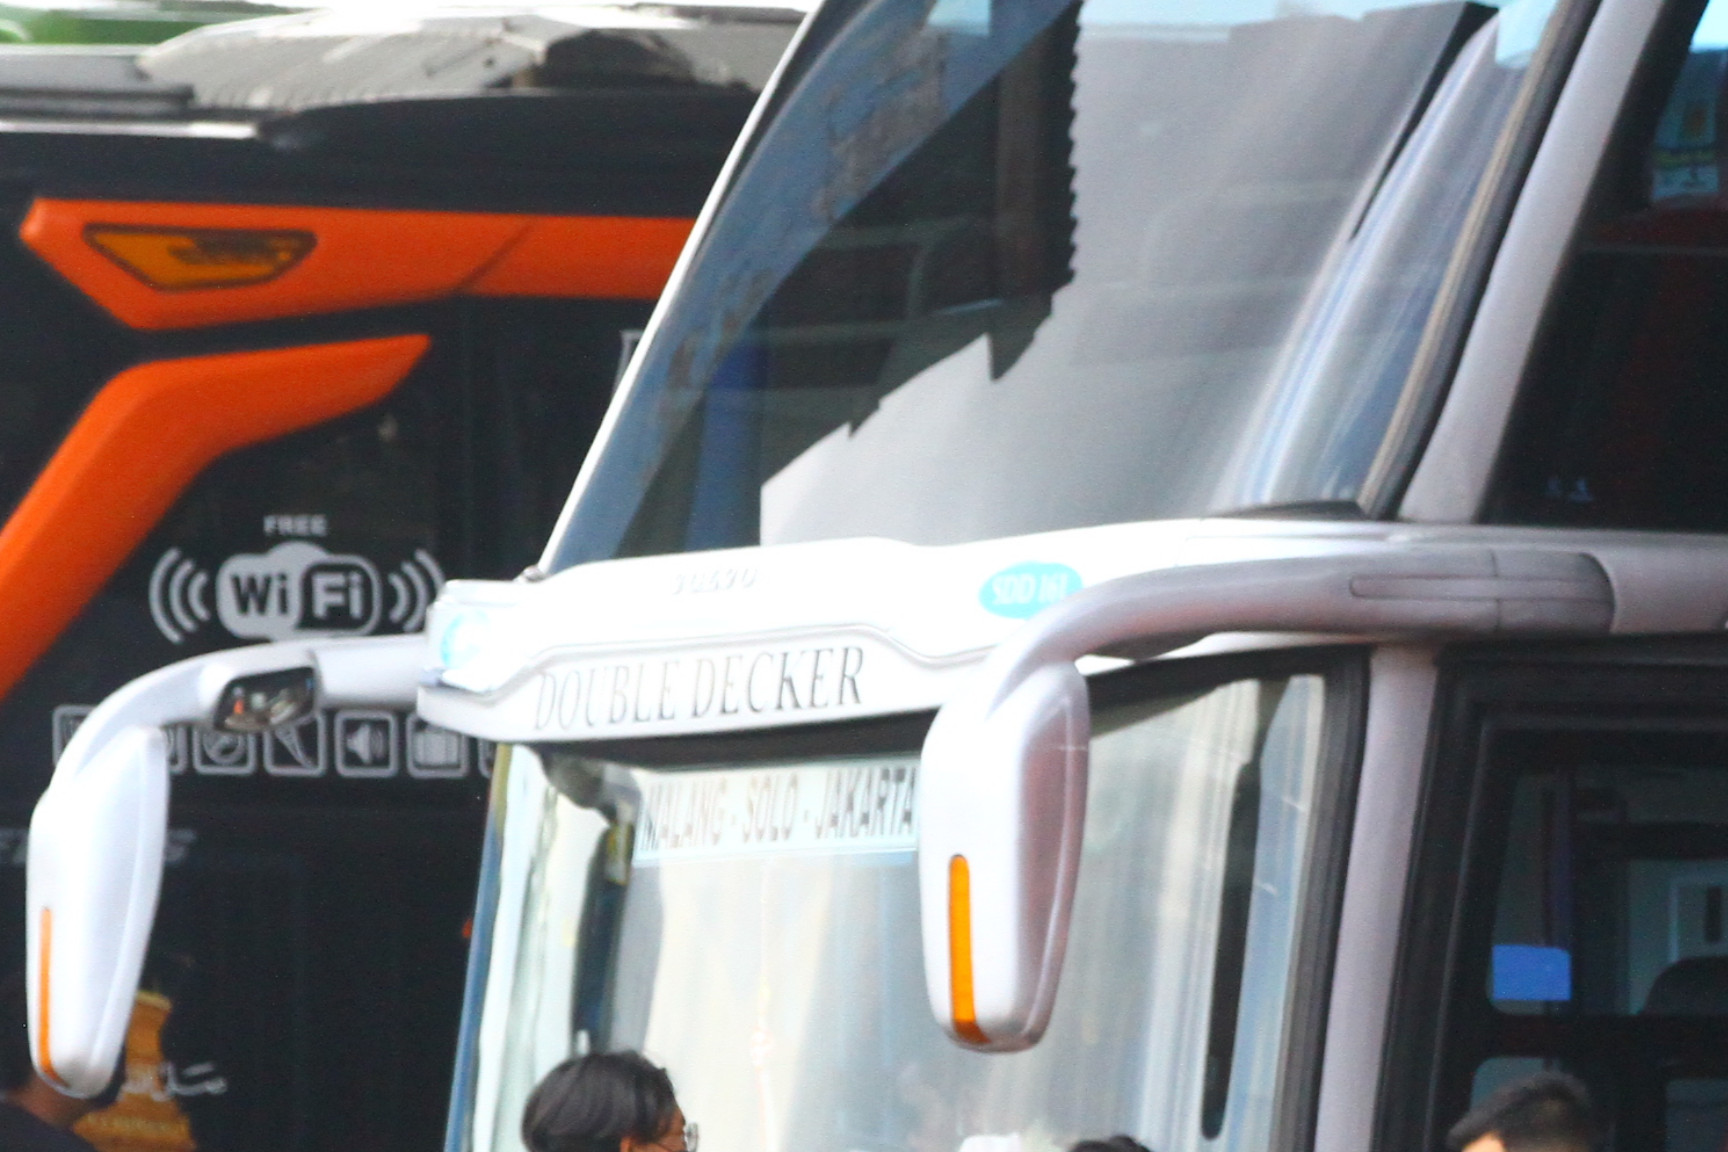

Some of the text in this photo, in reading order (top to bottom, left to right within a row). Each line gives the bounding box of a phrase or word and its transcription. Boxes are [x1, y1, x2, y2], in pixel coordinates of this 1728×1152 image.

[263, 514, 328, 536] FREE
[535, 645, 865, 731] DOUBLE DECKER
